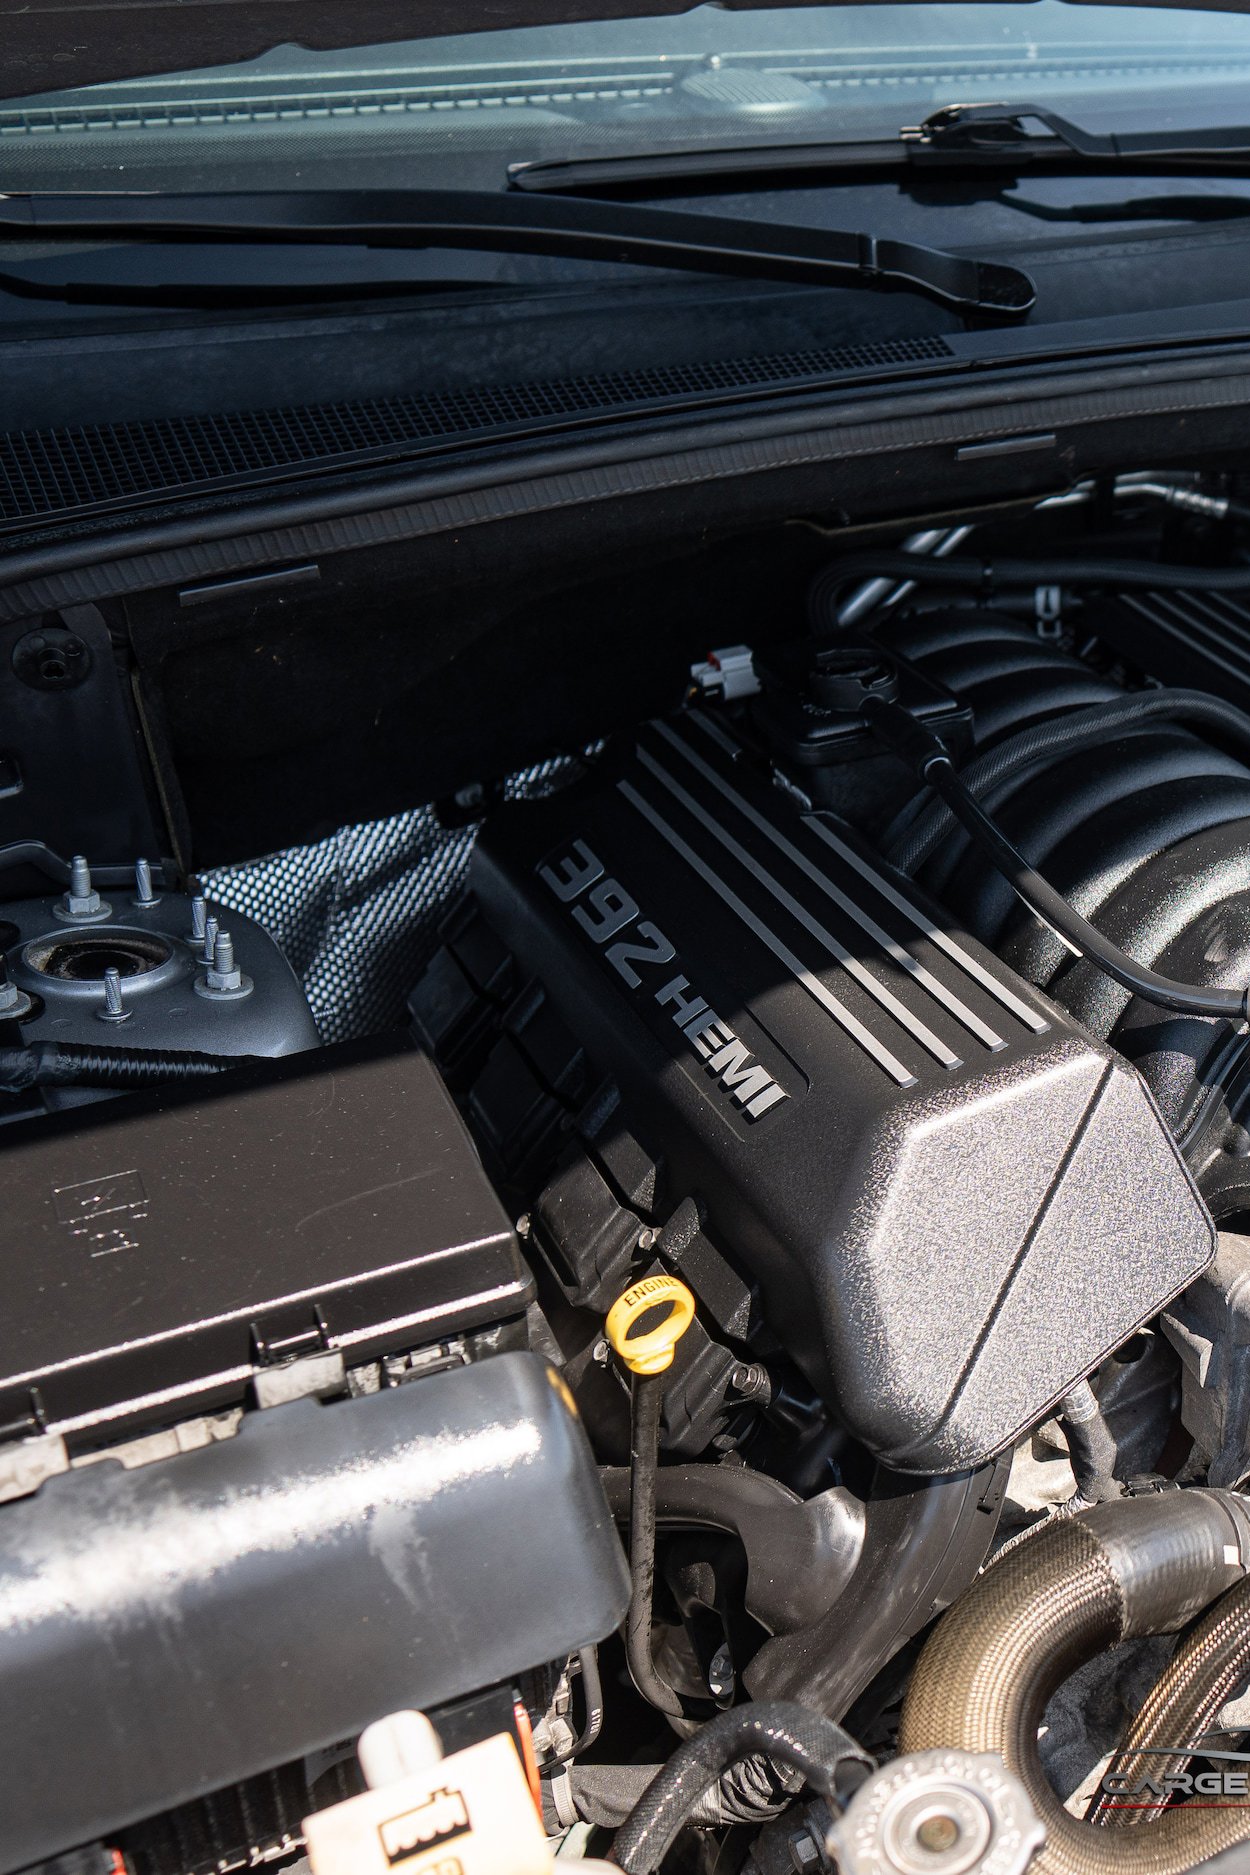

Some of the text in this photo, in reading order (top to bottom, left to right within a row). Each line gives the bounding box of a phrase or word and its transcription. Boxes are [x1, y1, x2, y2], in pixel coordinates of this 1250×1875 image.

[538, 838, 790, 1119] 392 HEMI
[624, 1277, 680, 1307] ENGINE
